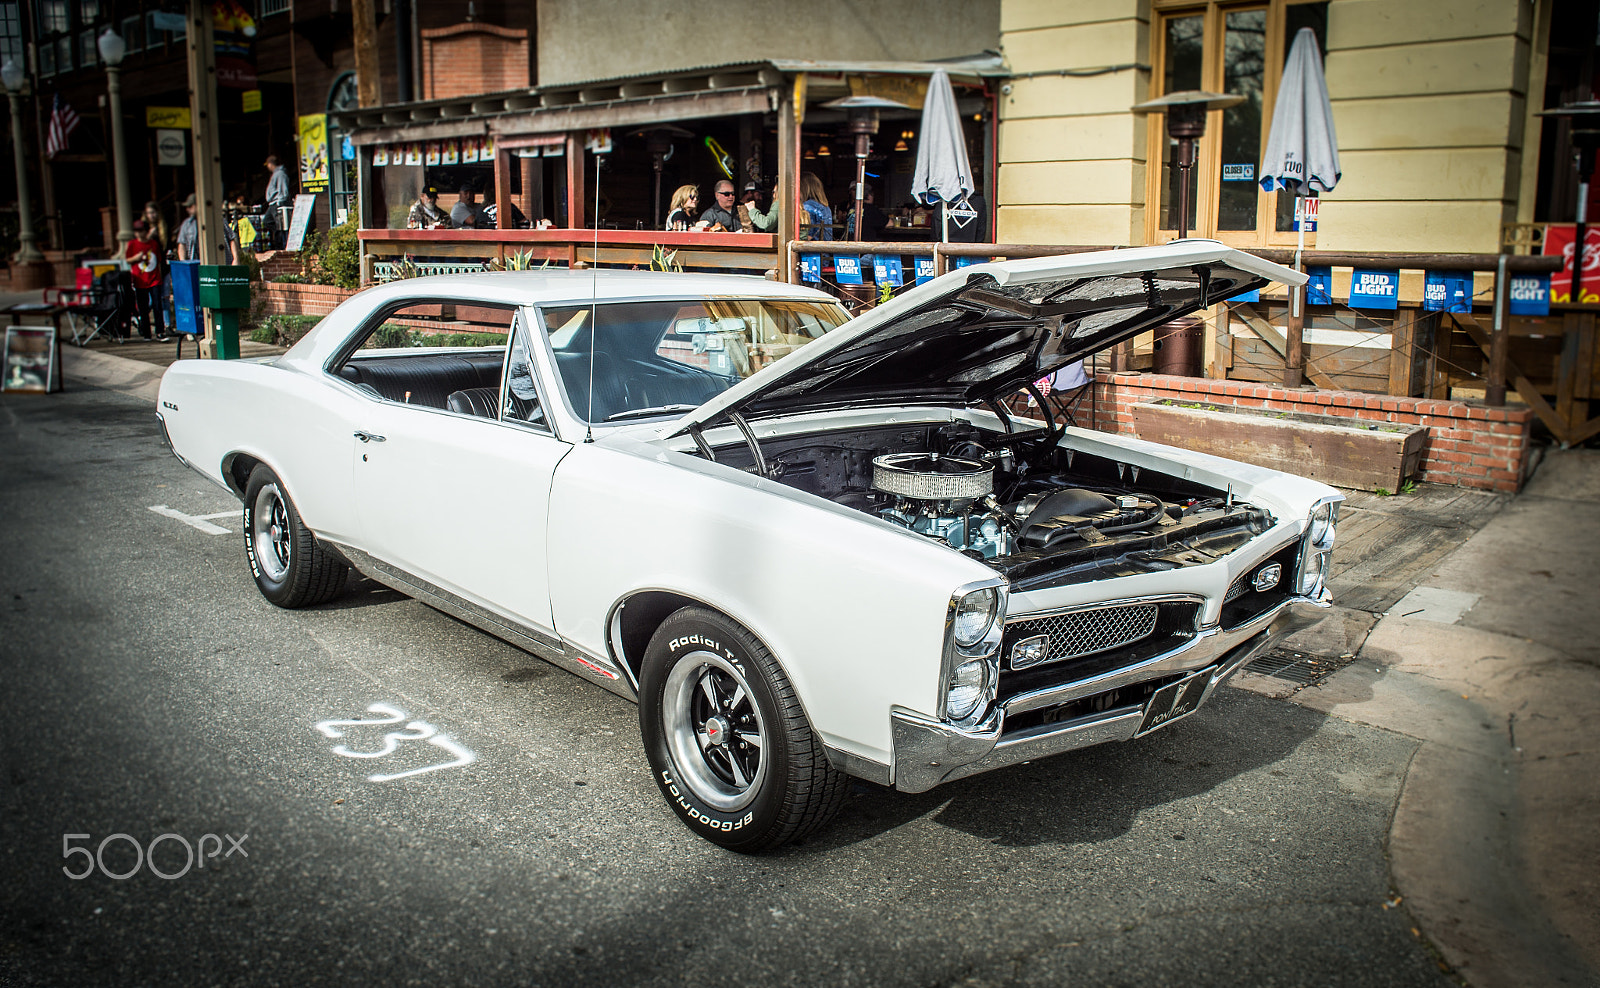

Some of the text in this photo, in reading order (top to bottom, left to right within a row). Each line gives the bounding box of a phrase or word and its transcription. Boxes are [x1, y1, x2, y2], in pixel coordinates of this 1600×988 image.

[1225, 166, 1243, 175] CLOSED
[839, 258, 855, 268] BUD
[920, 260, 934, 269] BU
[837, 266, 859, 275] LIGHT
[917, 267, 934, 277] LIG
[1361, 274, 1390, 285] BUD
[1354, 283, 1394, 296] LIGHT
[1427, 284, 1446, 293] BUD
[1510, 289, 1545, 300] IGHT
[245, 533, 261, 578] Radial
[668, 634, 747, 679] Radial T/A
[1151, 701, 1191, 726] PONTIAC
[661, 769, 754, 833] BFGoodrich
